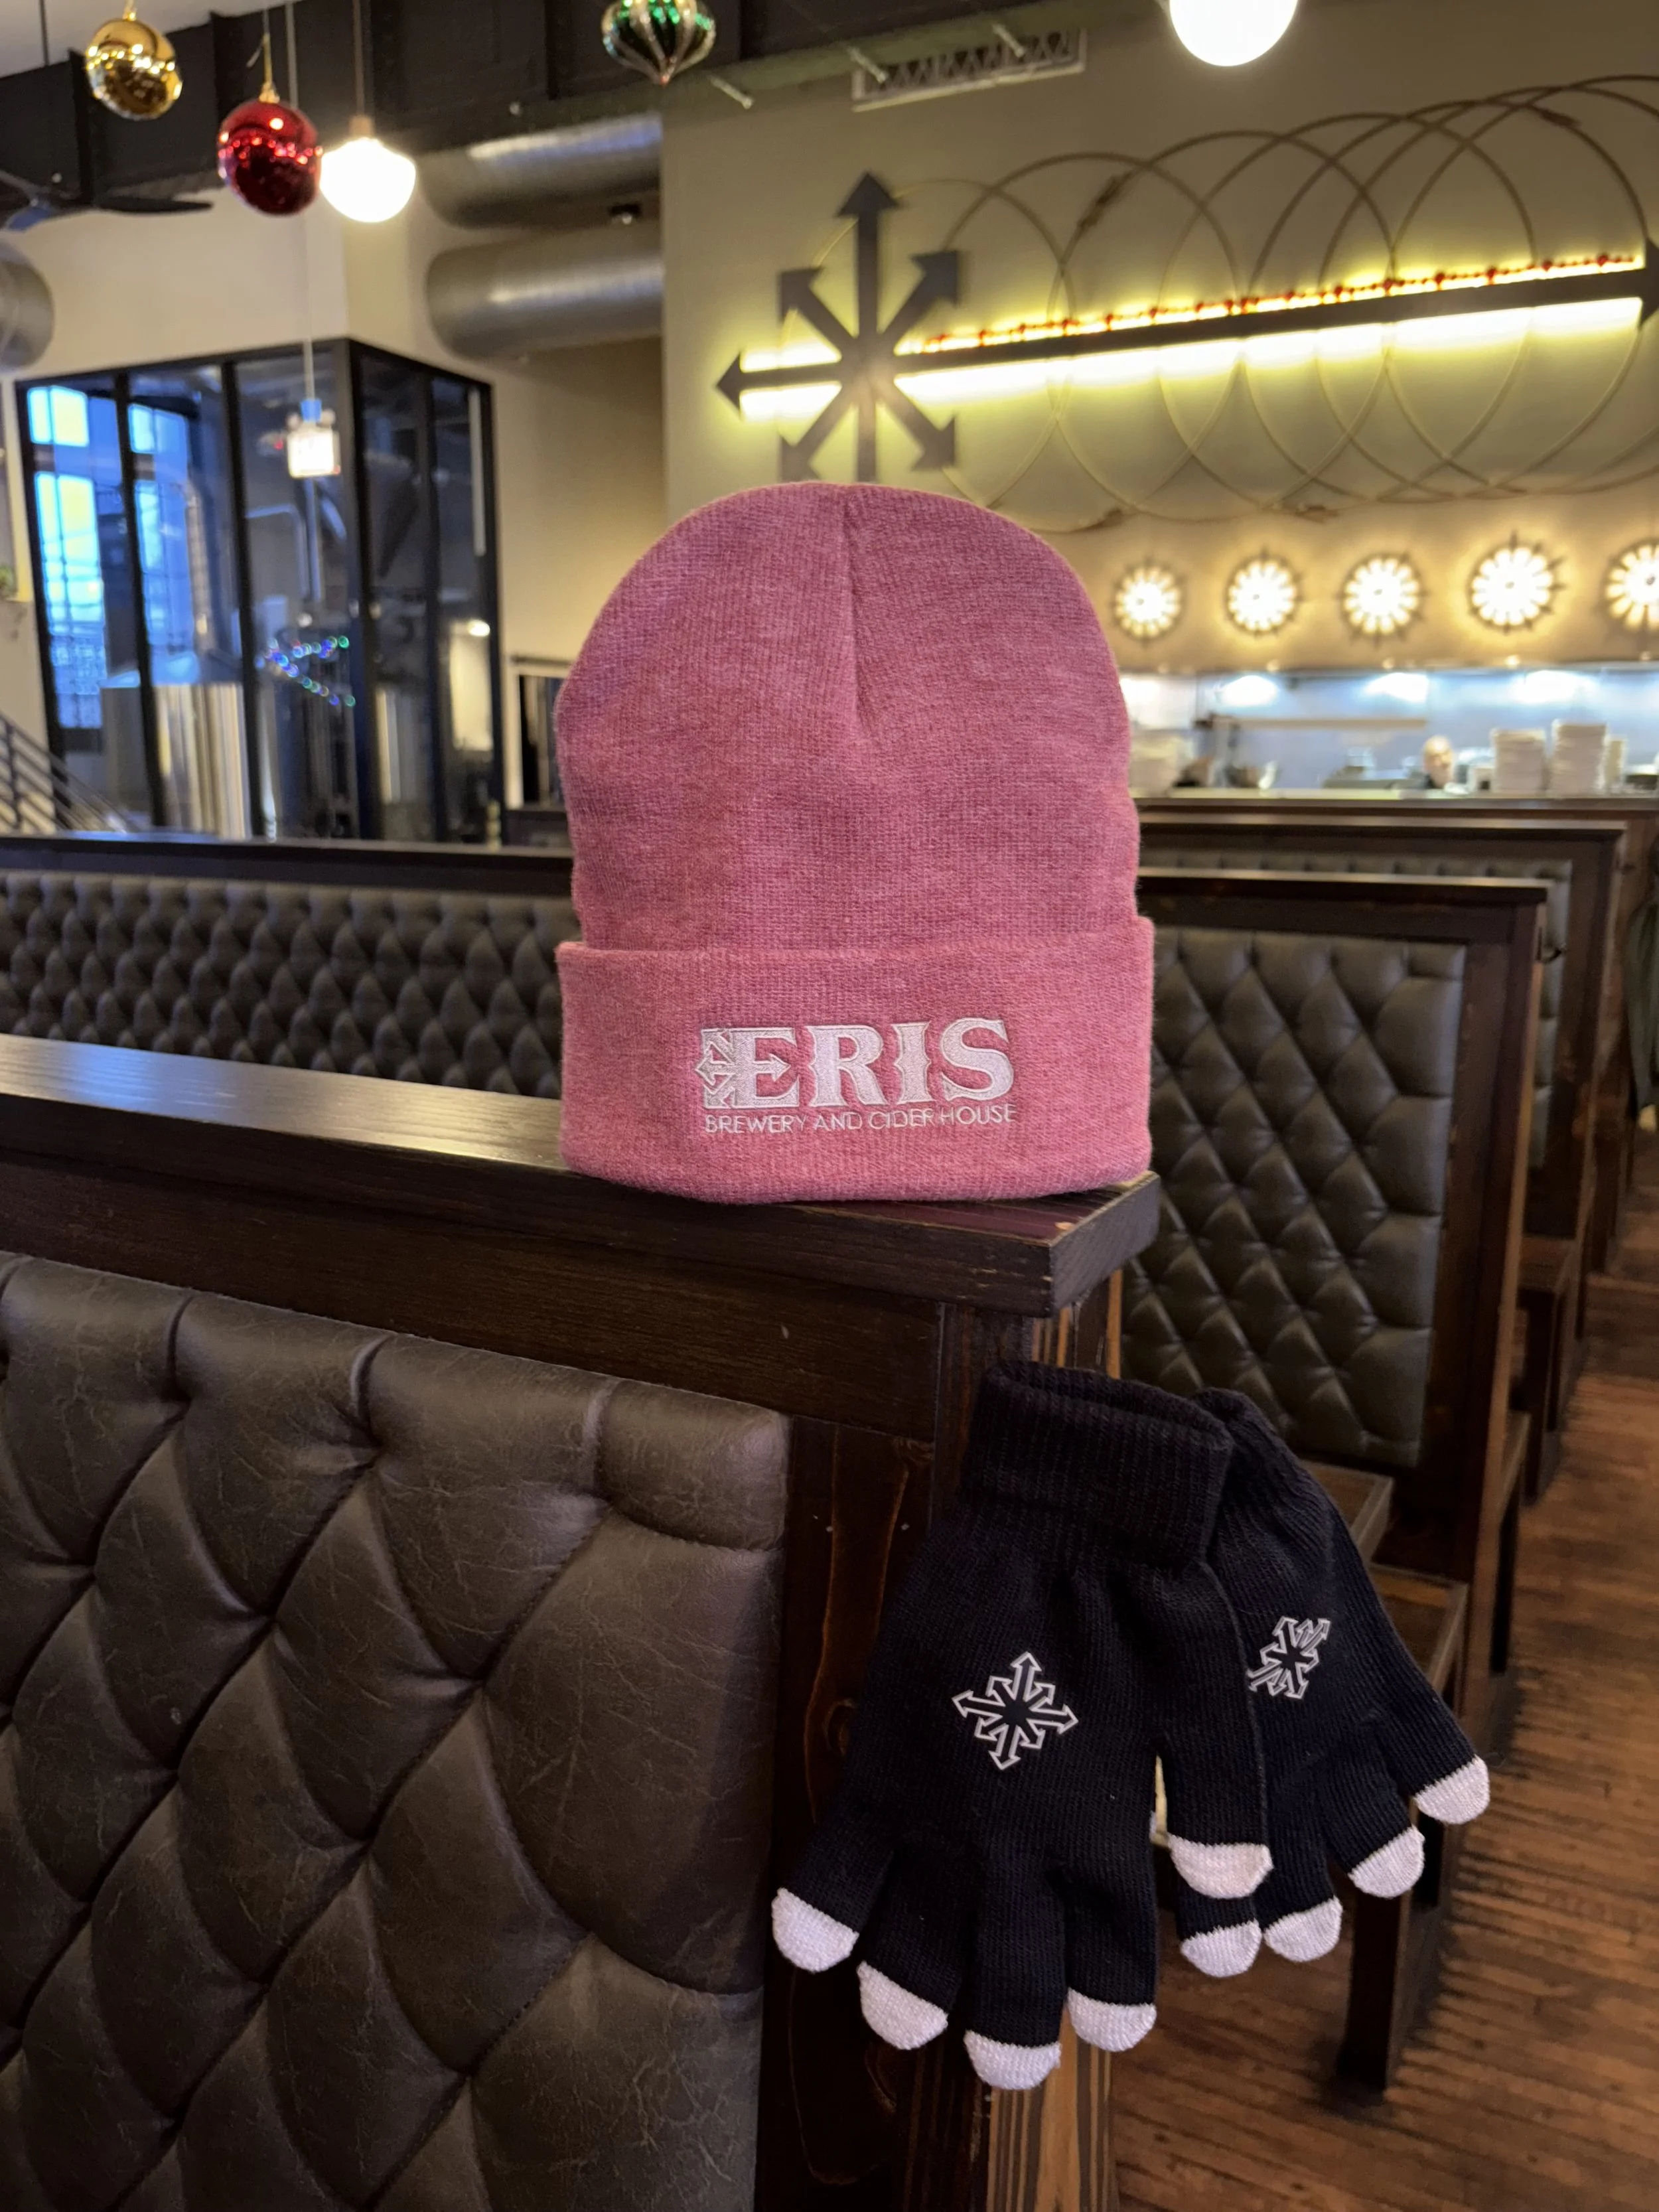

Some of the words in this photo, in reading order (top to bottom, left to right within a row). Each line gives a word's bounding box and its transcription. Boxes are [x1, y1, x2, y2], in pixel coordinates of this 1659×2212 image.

[700, 1017, 1014, 1109] ERIS
[705, 1114, 808, 1134] BREWERY
[814, 1111, 863, 1130] AND
[869, 1108, 935, 1130] CIDER
[940, 1103, 1017, 1126] HOUSE
